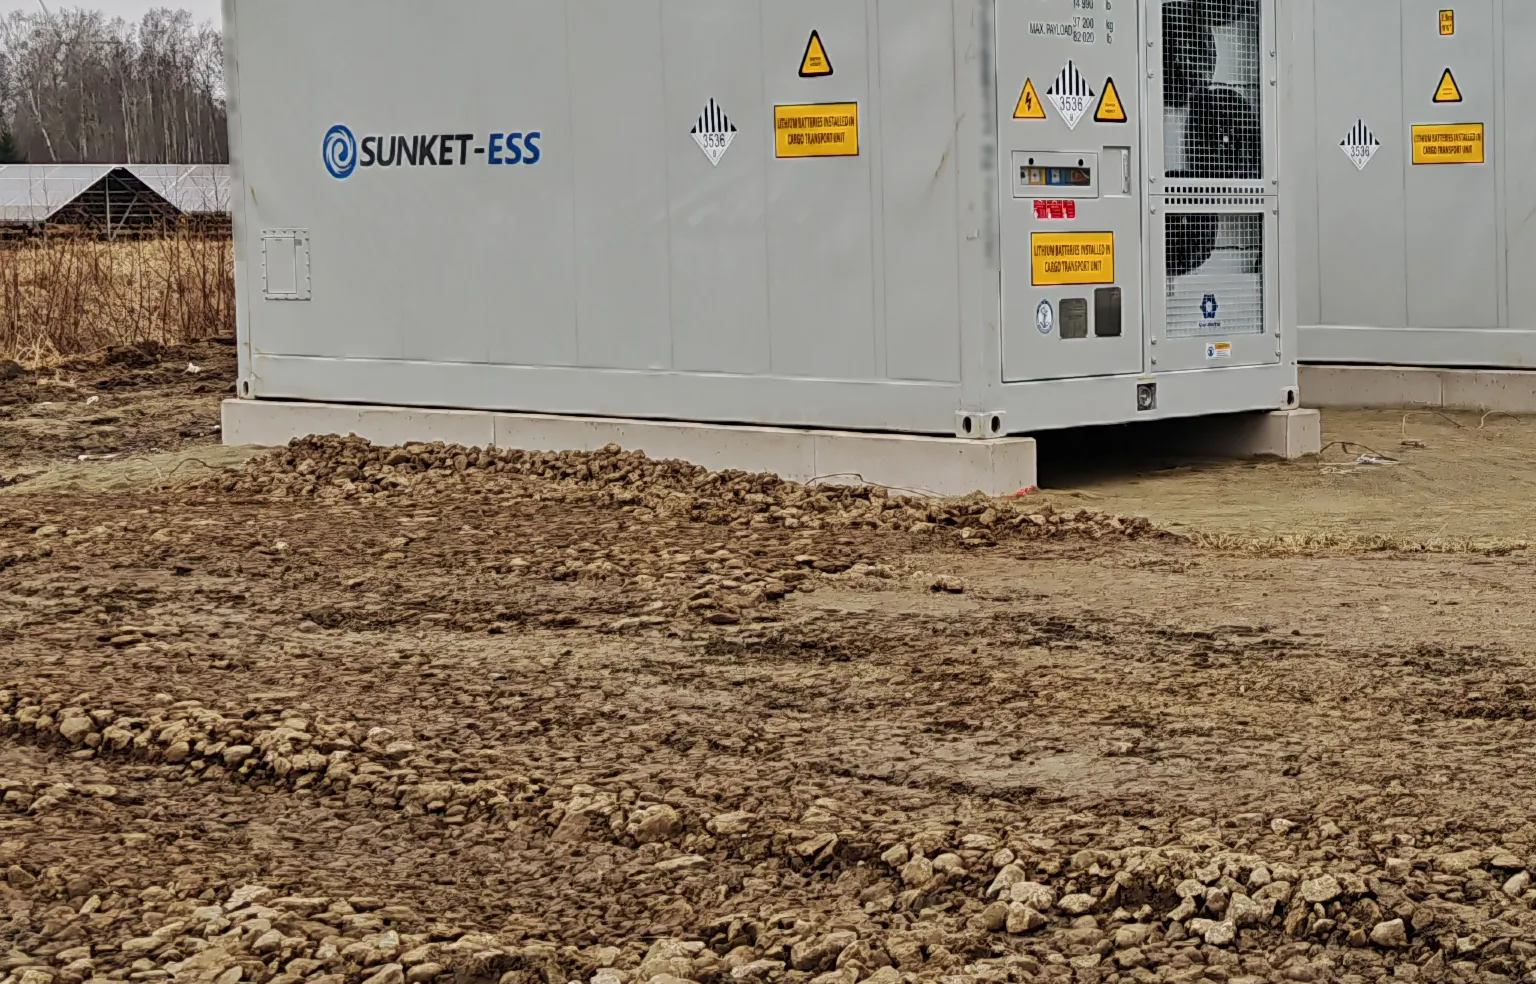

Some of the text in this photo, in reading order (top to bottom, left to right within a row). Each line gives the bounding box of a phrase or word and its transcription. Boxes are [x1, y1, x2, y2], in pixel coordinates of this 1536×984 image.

[1060, 96, 1083, 111] 3536
[703, 134, 725, 148] 3536
[359, 132, 541, 166] SUNKET-ESS
[1351, 146, 1370, 157] 3536
